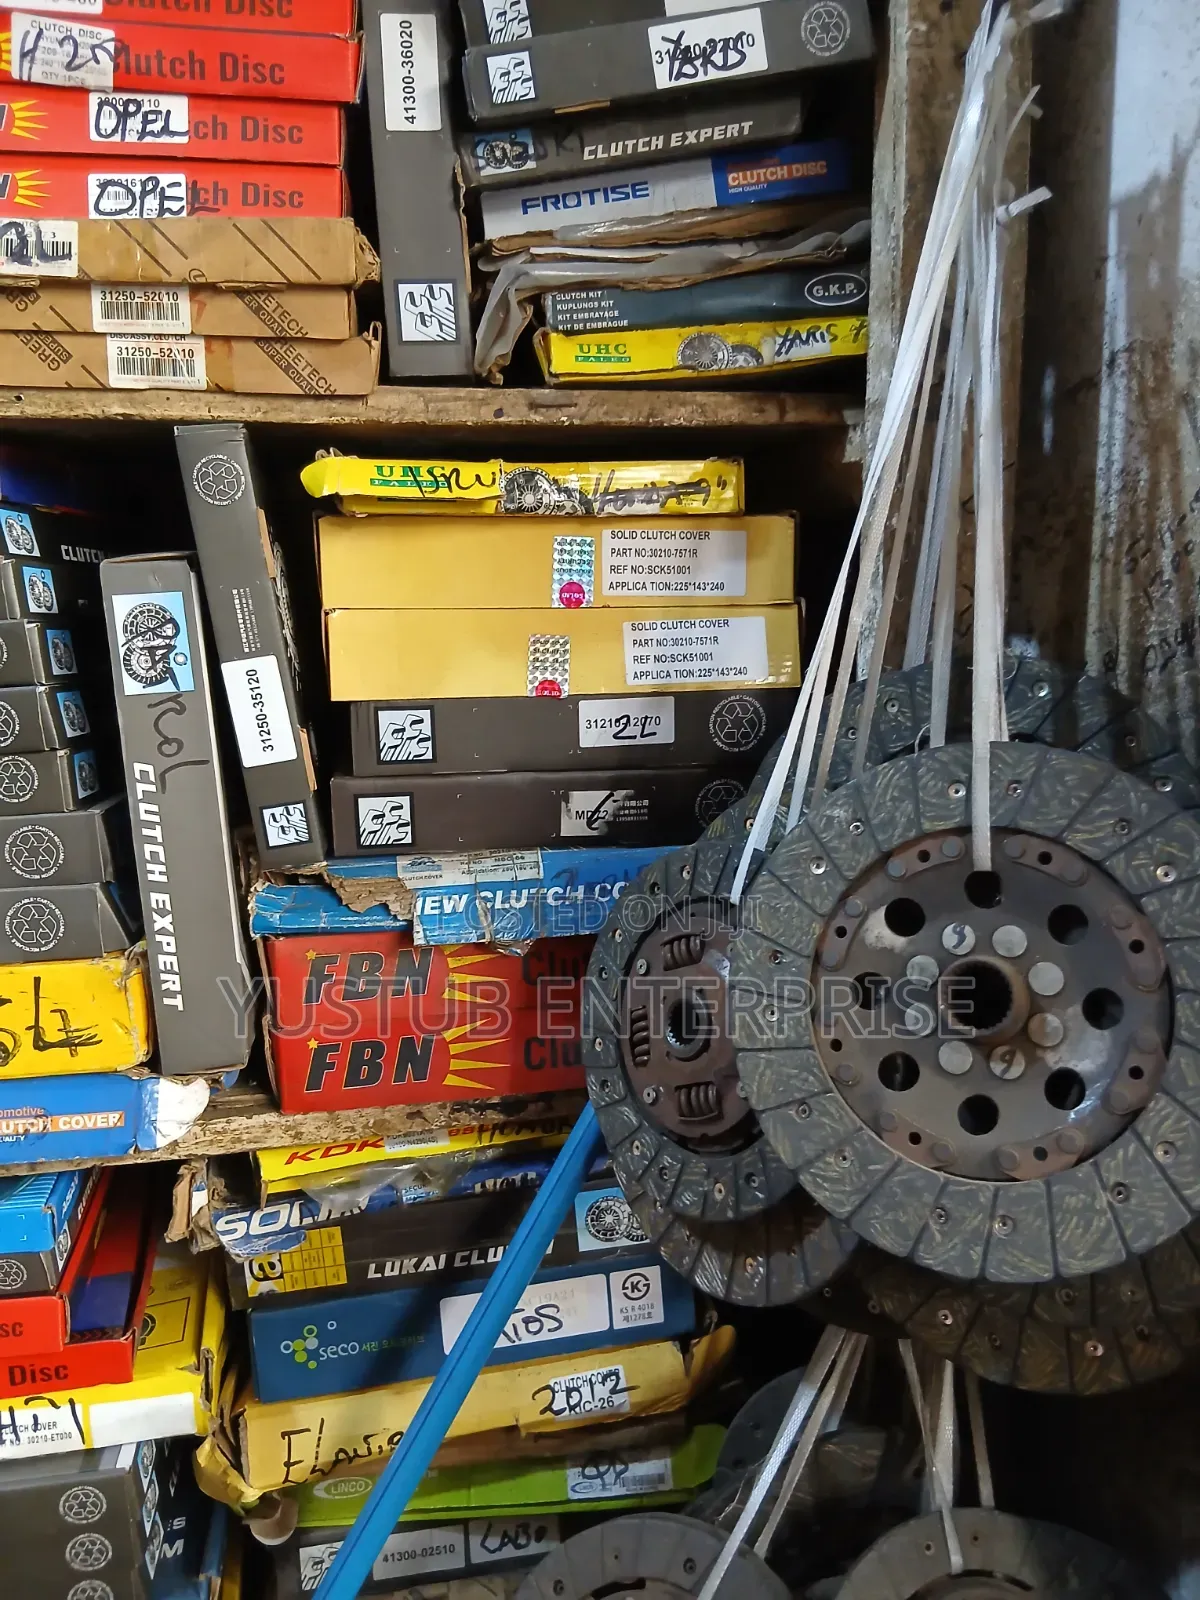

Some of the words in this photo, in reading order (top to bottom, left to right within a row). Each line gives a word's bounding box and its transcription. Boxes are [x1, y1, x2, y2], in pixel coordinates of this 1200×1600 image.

[31, 20, 73, 35] CLUTCH
[79, 28, 102, 41] DISC
[219, 54, 286, 86] Disc
[399, 19, 417, 125] 41300-36020
[94, 98, 190, 142] OPEL
[241, 115, 304, 145] Disc
[583, 134, 664, 161] CLUTCH
[670, 121, 754, 148] EXPERT
[728, 165, 788, 186] CLUTCH
[792, 160, 828, 177] DISC
[241, 181, 304, 209] Disc
[521, 180, 650, 216] FROTISE
[556, 291, 587, 301] CLUTCH
[589, 290, 602, 298] KIT
[812, 282, 858, 297] G.K.P.
[573, 310, 620, 320] EMBRAYAGE
[601, 300, 614, 308] KIT
[586, 319, 629, 330] EMBRAGUE
[576, 343, 627, 355] UHC
[610, 530, 638, 540] SOLID
[640, 530, 677, 541] CLUTCH
[678, 530, 711, 541] COVER
[610, 548, 633, 558] PART
[634, 548, 698, 559] NO:30210-7571R
[609, 565, 628, 575] REF
[630, 565, 692, 576] NO:SCK51001
[608, 581, 647, 592] APPLICA
[631, 622, 658, 632] SOLID
[660, 620, 697, 631] CLUTCH
[698, 618, 730, 629] COVER
[632, 638, 654, 648] PART
[656, 636, 719, 648] NO:30210-7571R
[632, 655, 652, 665] REF
[653, 652, 714, 664] NO:SCK51001
[632, 670, 672, 681] APPLICA
[246, 668, 274, 753] 31250-35120
[612, 714, 657, 740] 2L
[133, 762, 170, 883] CLUTCH
[475, 885, 585, 911] CLUTCH
[149, 892, 184, 1012] EXPERT
[302, 947, 435, 1006] FBN
[522, 950, 588, 986] Clu
[303, 1034, 436, 1094] FBN
[523, 1036, 587, 1071] Clu
[1, 1117, 52, 1135] UTCH
[58, 1112, 121, 1131] COVER
[284, 1137, 387, 1166] KDK
[367, 1253, 448, 1279] LUKAI
[631, 1305, 637, 1314] R
[637, 1303, 655, 1312] 4018
[318, 1341, 360, 1361] seco
[8, 1364, 70, 1387] Disc
[331, 1481, 366, 1495] LINCO
[382, 1543, 456, 1565] 41300-02510
